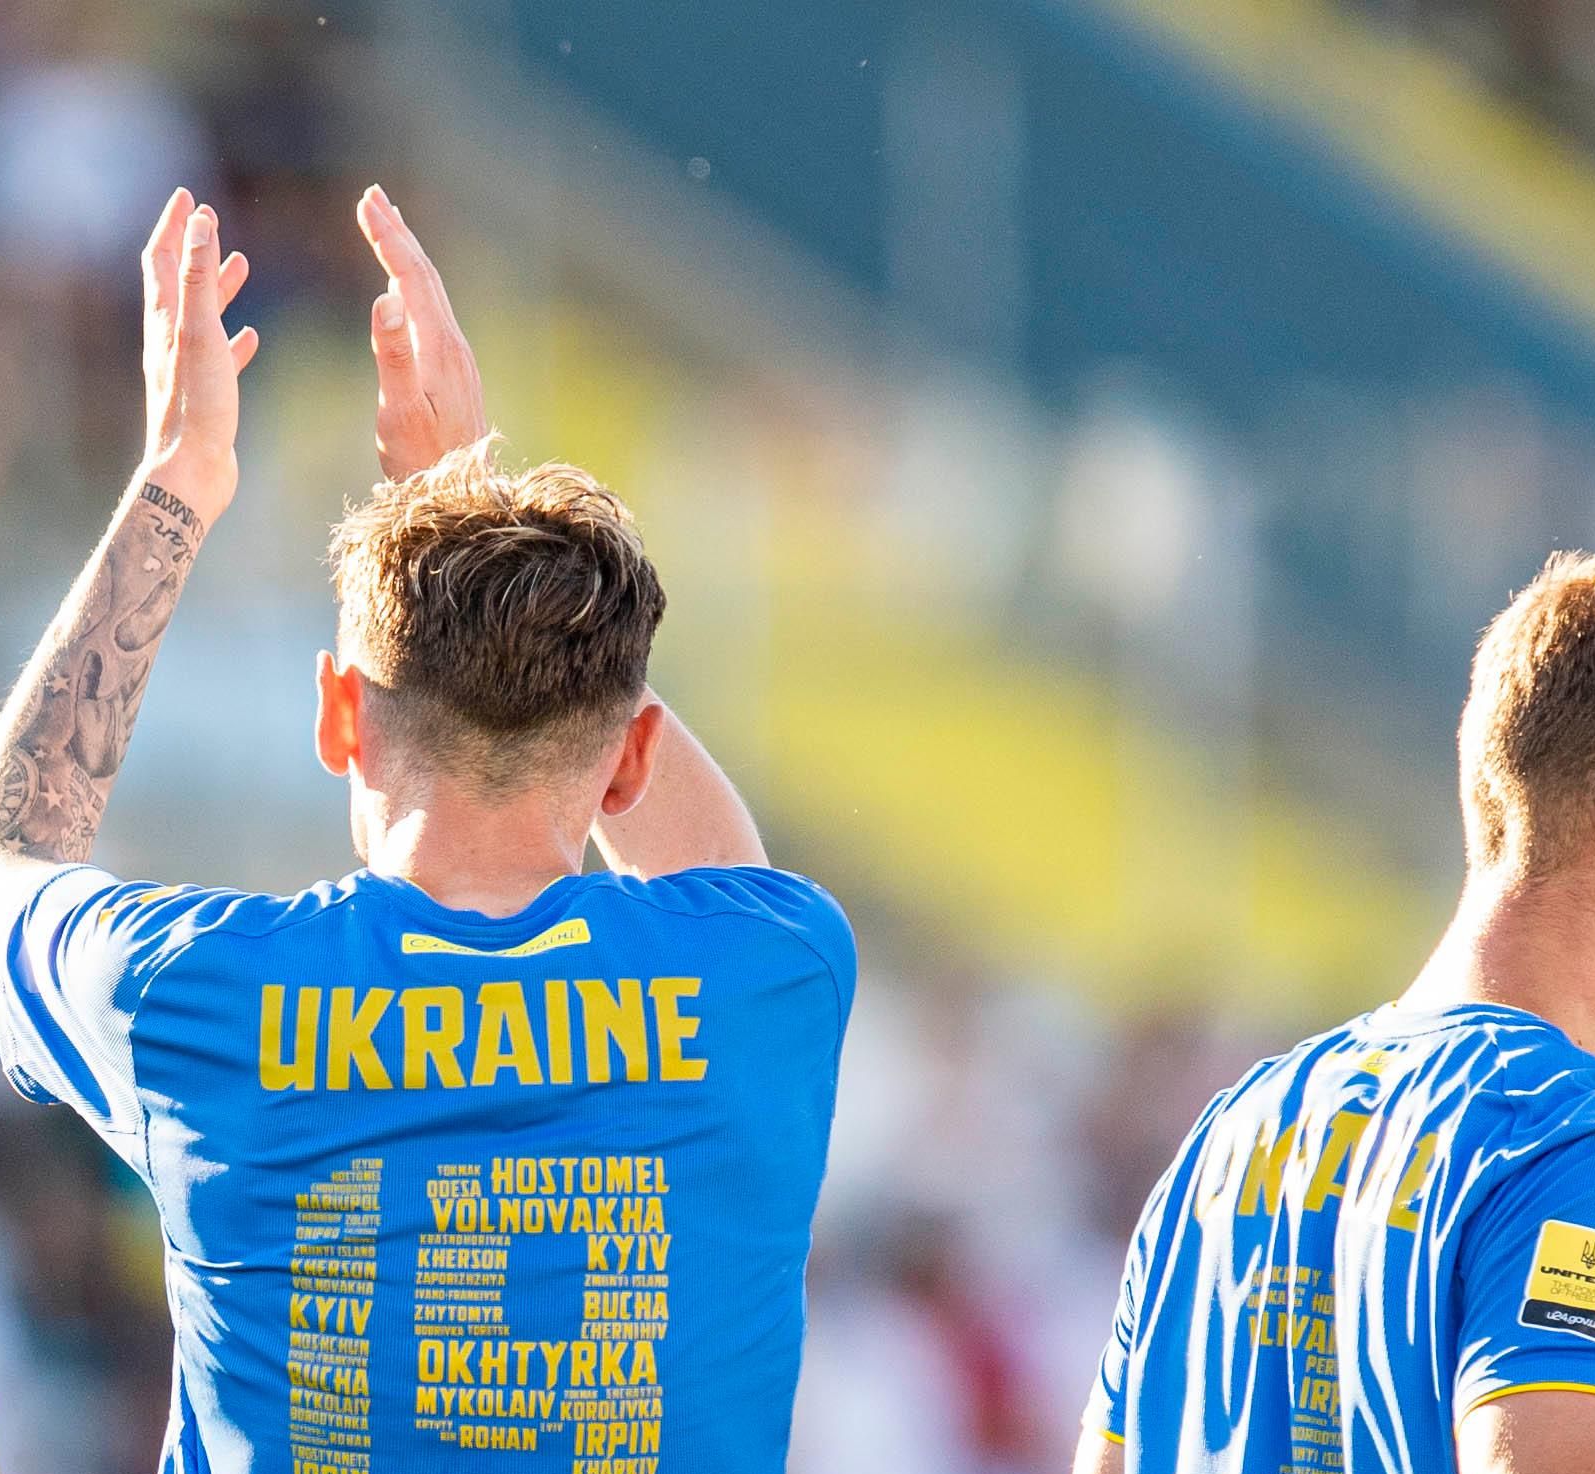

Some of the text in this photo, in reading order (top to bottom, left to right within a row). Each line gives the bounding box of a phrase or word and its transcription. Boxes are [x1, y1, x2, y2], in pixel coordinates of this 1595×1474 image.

[259, 977, 709, 1091] UKRAINE
[427, 1180, 482, 1198] ODESA
[491, 1157, 670, 1194] HOSTOMEL
[296, 1194, 380, 1211] MARIUPOL
[431, 1198, 665, 1234] VOLNOVAKHA
[417, 1248, 508, 1269] KHERSON
[587, 1234, 672, 1273] KYIV
[290, 1258, 376, 1280] KHERSON
[290, 1293, 373, 1336] KYIV
[414, 1304, 503, 1322] ZHYTOMYR
[583, 1291, 668, 1320] BUCHA
[581, 1322, 668, 1340] CHERNIHIV
[287, 1362, 369, 1396] BUCHA
[418, 1340, 657, 1390] OKHTYRKA
[290, 1388, 371, 1416] MYKOLAIV
[416, 1387, 556, 1419] MYKOLAIV
[560, 1398, 662, 1421] KOROLIVKA
[460, 1425, 537, 1451] ROHAN
[574, 1420, 662, 1457] IRPIN
